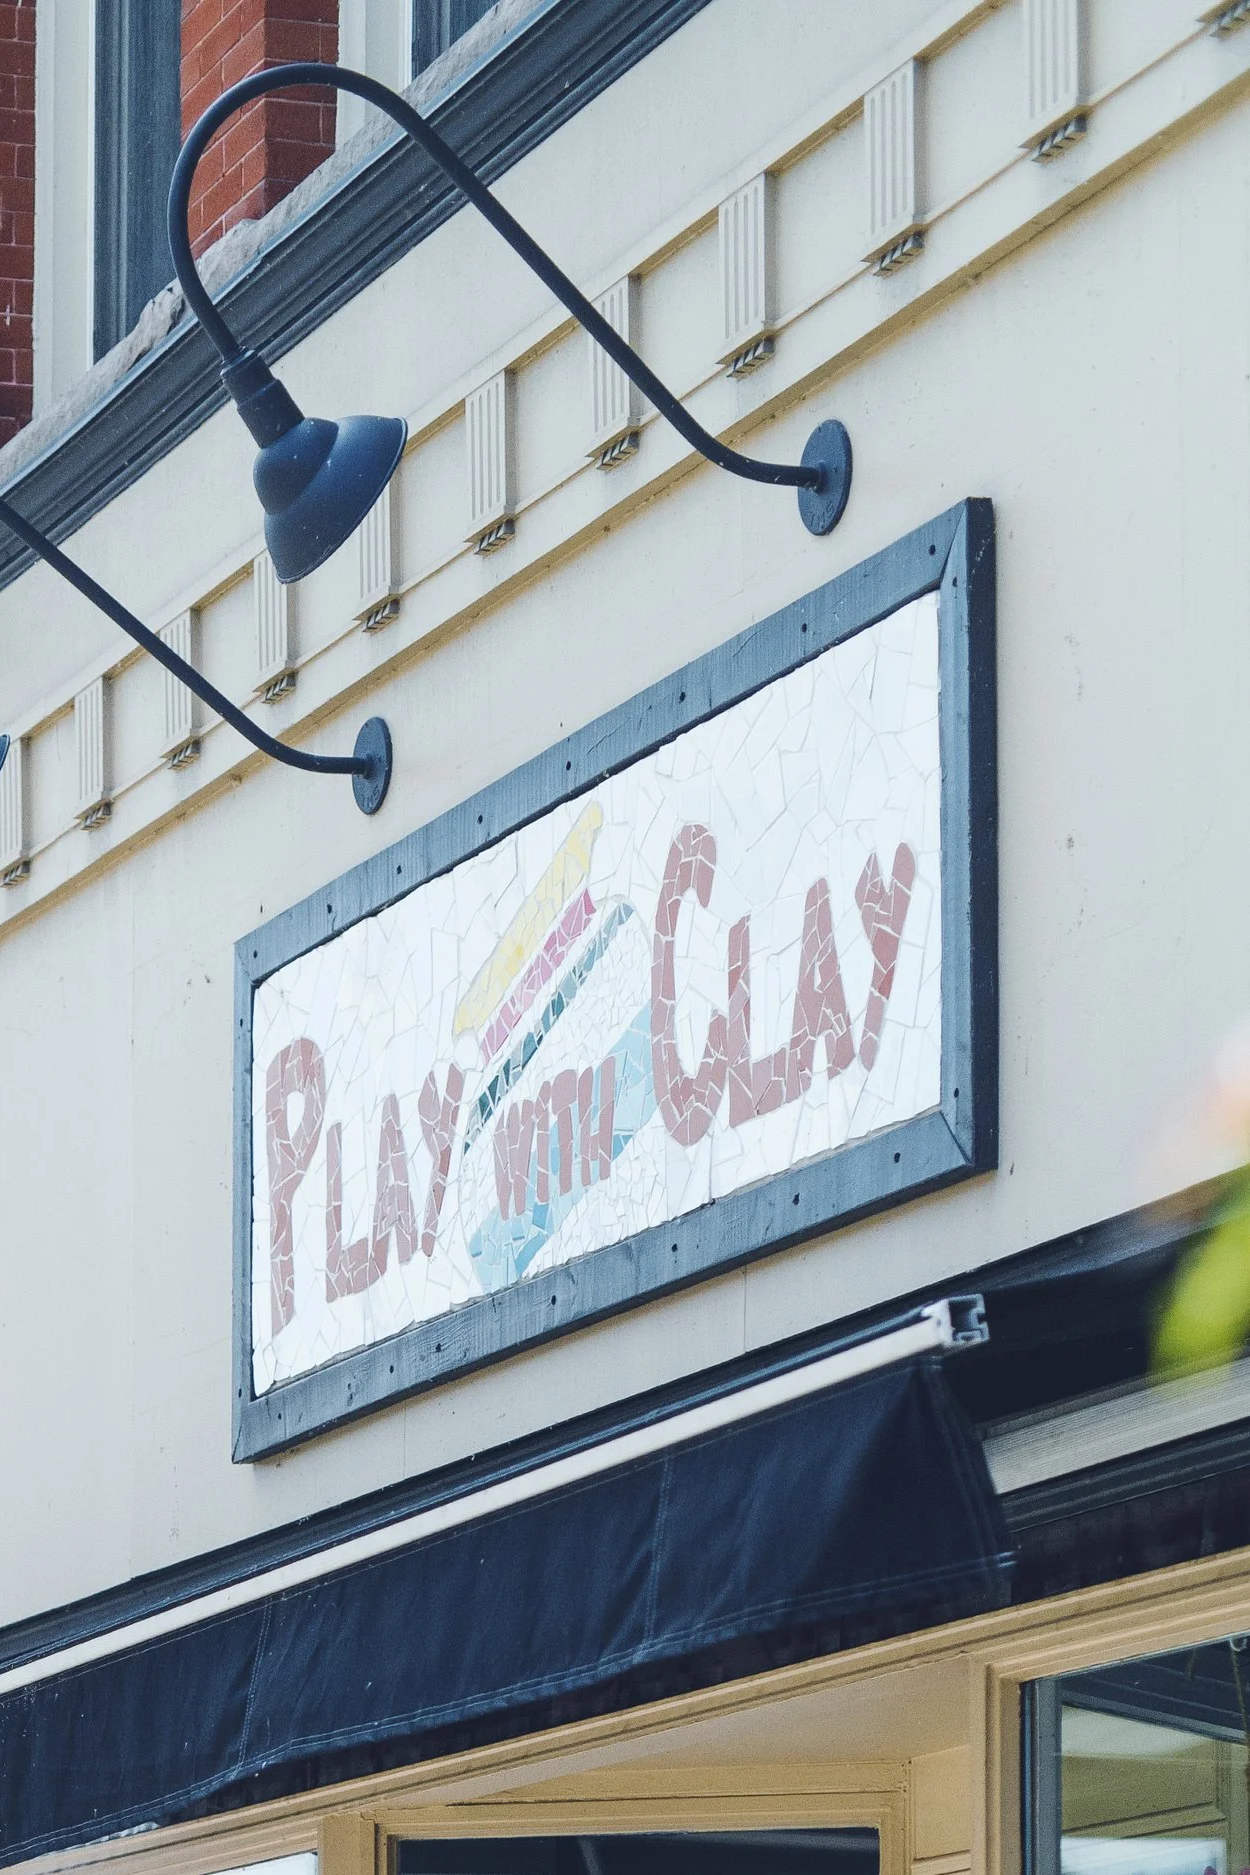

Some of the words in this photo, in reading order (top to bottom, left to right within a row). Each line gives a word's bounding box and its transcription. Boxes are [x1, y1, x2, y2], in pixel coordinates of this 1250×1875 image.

[266, 1036, 463, 1337] PLAY
[493, 1056, 616, 1222] WITH
[650, 823, 917, 1147] CLAY
